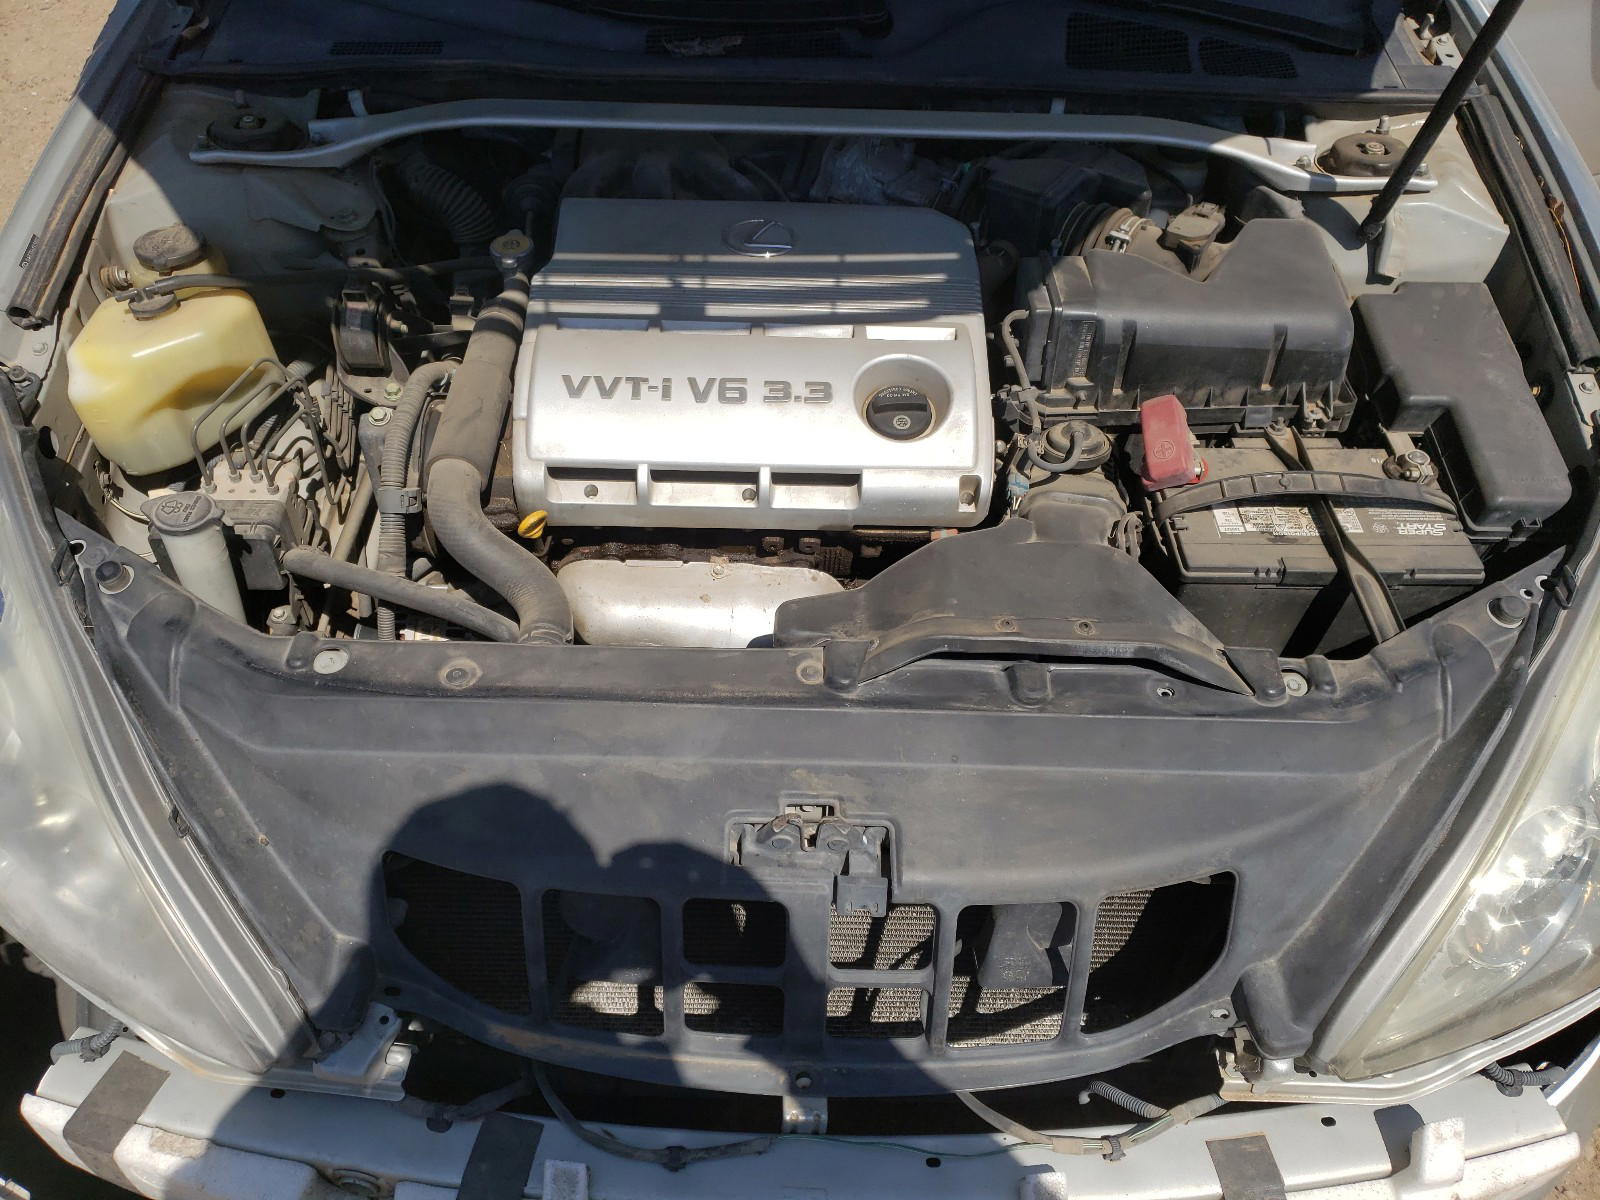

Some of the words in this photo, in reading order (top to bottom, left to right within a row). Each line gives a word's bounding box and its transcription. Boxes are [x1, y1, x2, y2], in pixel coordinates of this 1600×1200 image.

[561, 374, 672, 401] VVT-i
[687, 376, 748, 404] V6
[763, 380, 834, 404] 3.3
